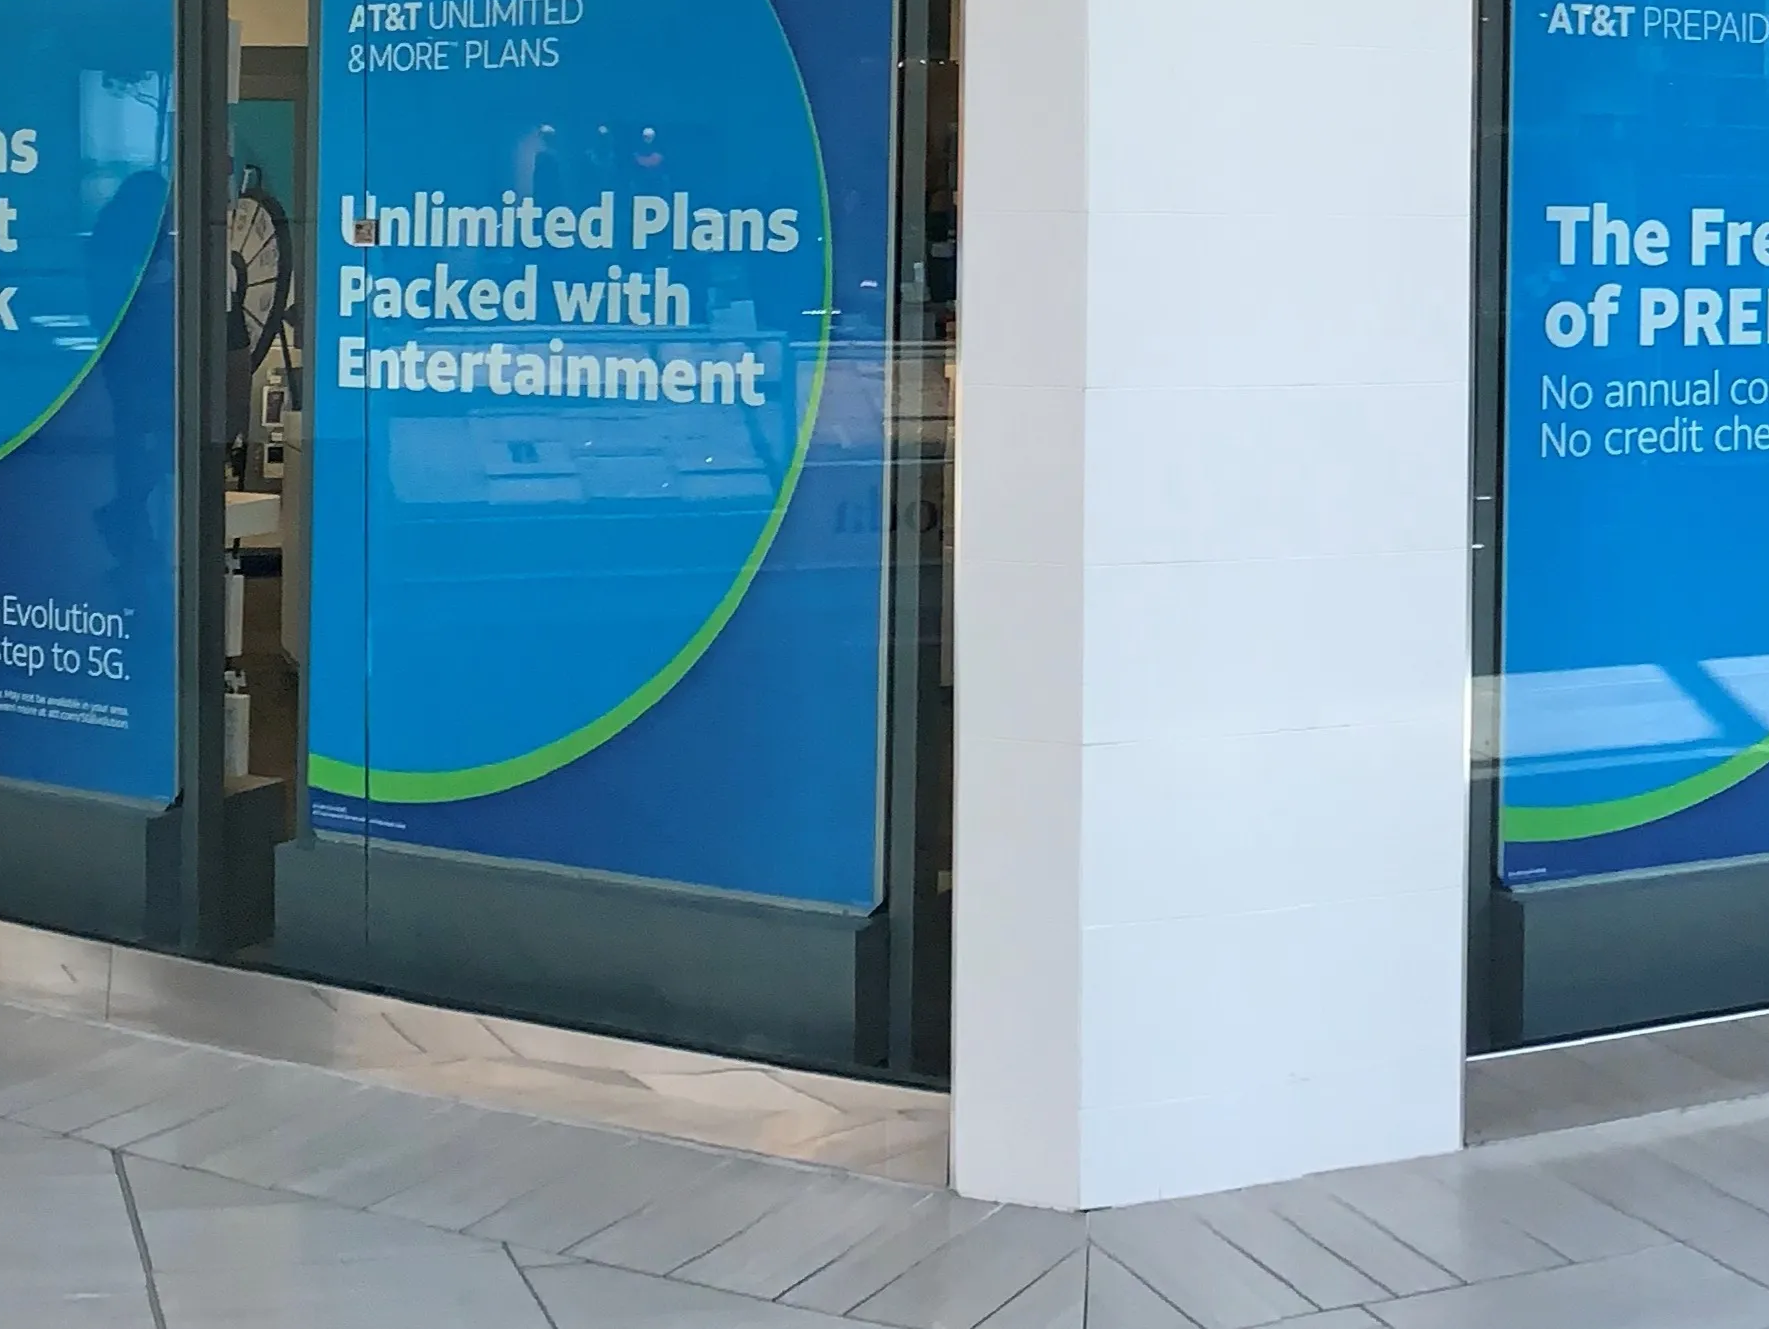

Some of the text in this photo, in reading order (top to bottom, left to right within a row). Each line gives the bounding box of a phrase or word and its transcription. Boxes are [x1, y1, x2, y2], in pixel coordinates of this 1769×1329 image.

[348, 3, 422, 35] AT&T
[1547, 3, 1635, 37] AT&T
[464, 37, 560, 70] PLANS
[341, 191, 799, 253] Unlimited Plans
[1546, 203, 1669, 265] The
[339, 264, 689, 326] Packed with
[1544, 284, 1622, 348] of
[338, 336, 765, 407] Entertainment
[1540, 374, 1594, 410] No
[1604, 370, 1720, 406] annual
[1540, 422, 1592, 458] No
[1603, 417, 1704, 454] credit
[52, 642, 79, 672] to
[87, 646, 130, 680] 5G.
